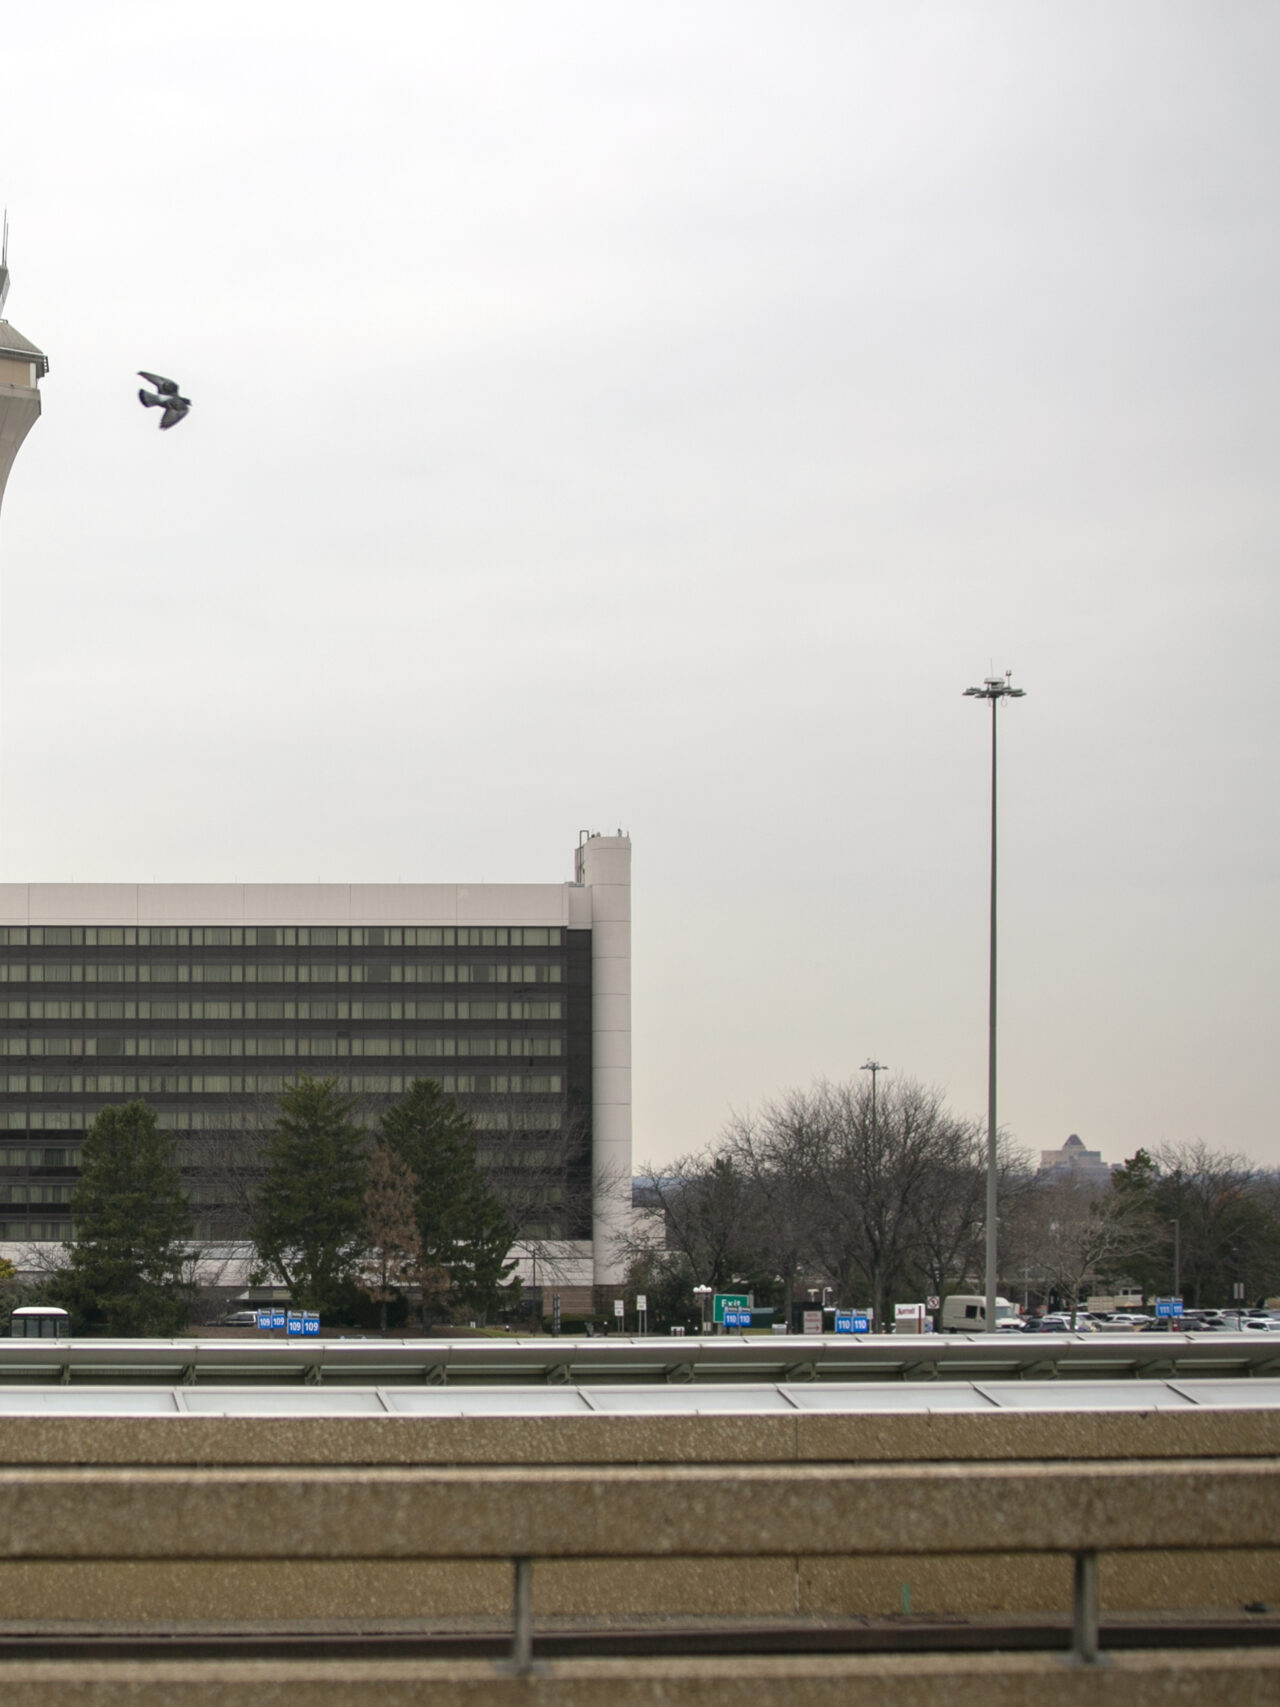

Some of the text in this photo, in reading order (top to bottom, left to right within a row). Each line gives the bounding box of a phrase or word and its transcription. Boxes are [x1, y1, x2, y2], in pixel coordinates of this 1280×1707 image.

[273, 1317, 285, 1326] 109
[289, 1321, 301, 1331] 109
[304, 1321, 319, 1331] 109
[838, 1320, 851, 1329] 110
[854, 1319, 867, 1329] 110
